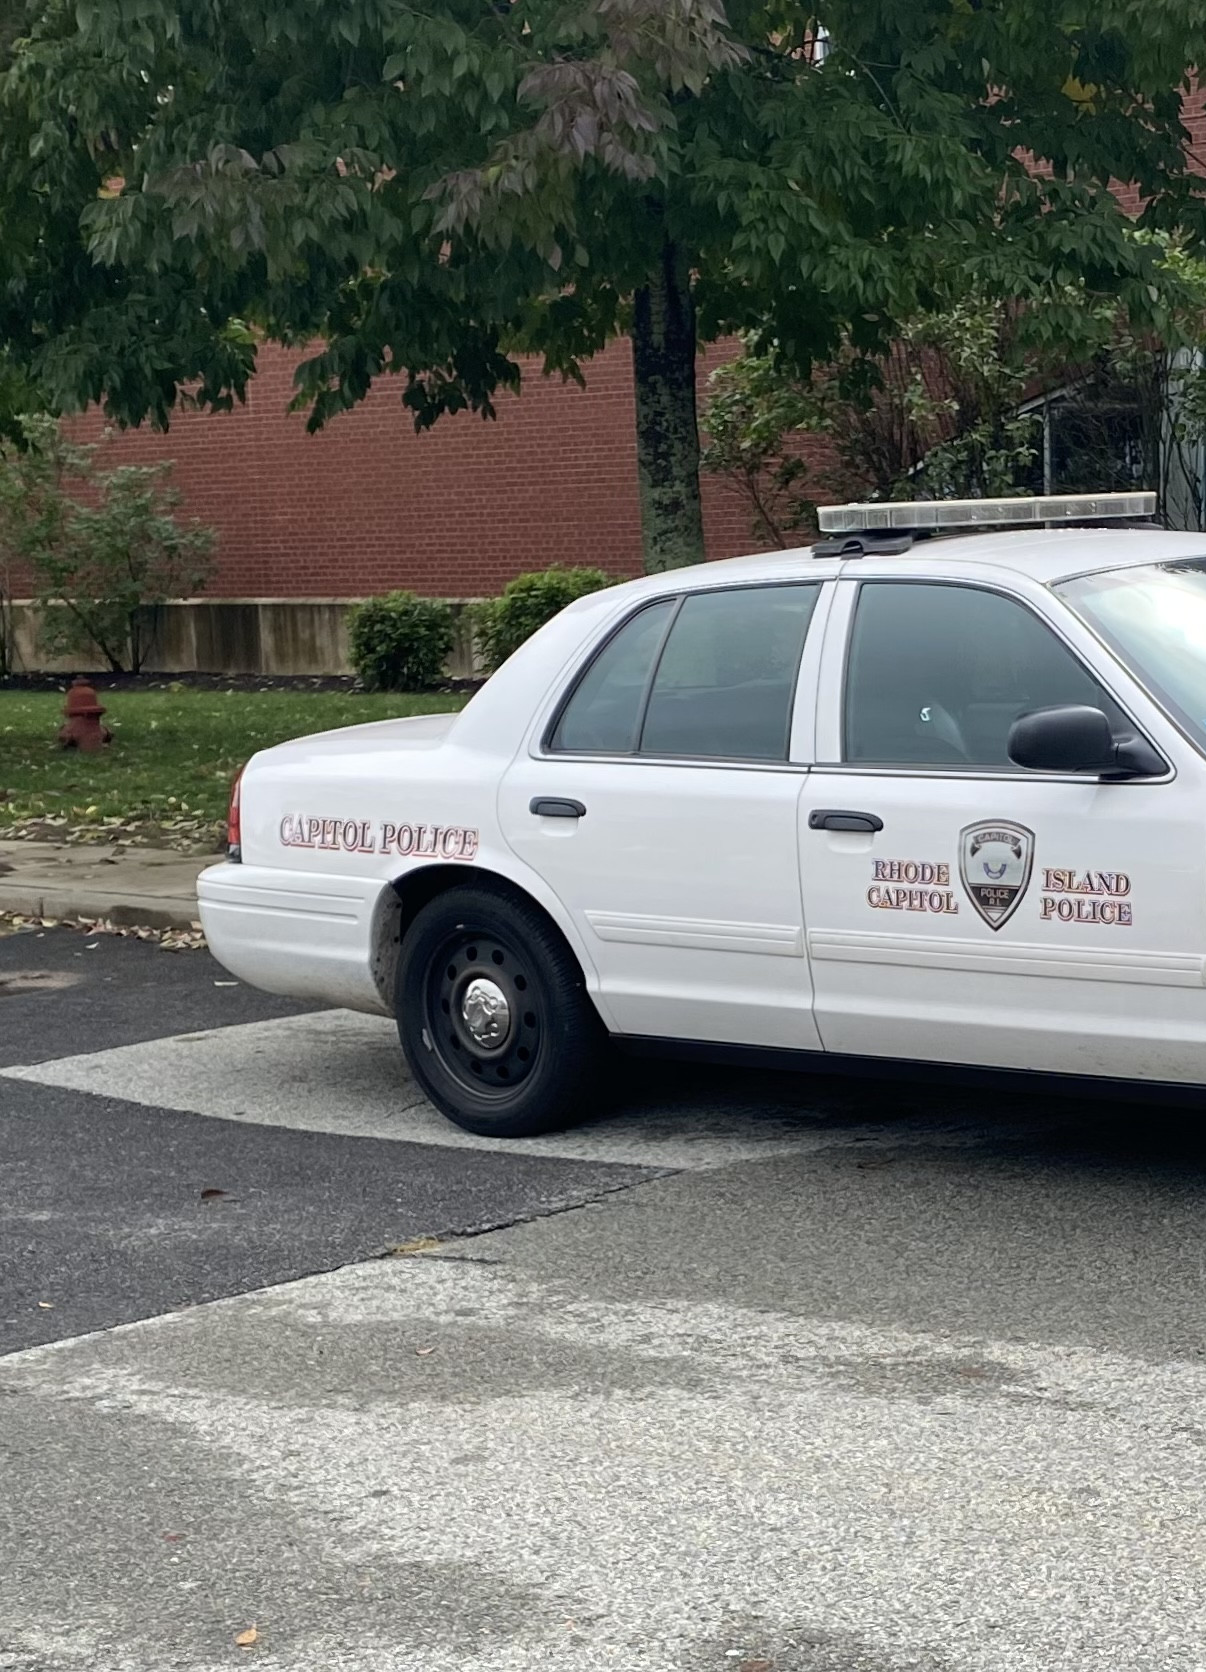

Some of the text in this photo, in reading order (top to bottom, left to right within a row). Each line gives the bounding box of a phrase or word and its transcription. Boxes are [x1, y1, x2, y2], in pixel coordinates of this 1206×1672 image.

[279, 813, 480, 861] CAPITOL POLICE
[977, 832, 1016, 845] CAPITOL
[872, 858, 1132, 896] RHODE ISLAND
[980, 888, 1010, 899] POLICE
[866, 885, 1132, 925] CAPITOL POLICE
